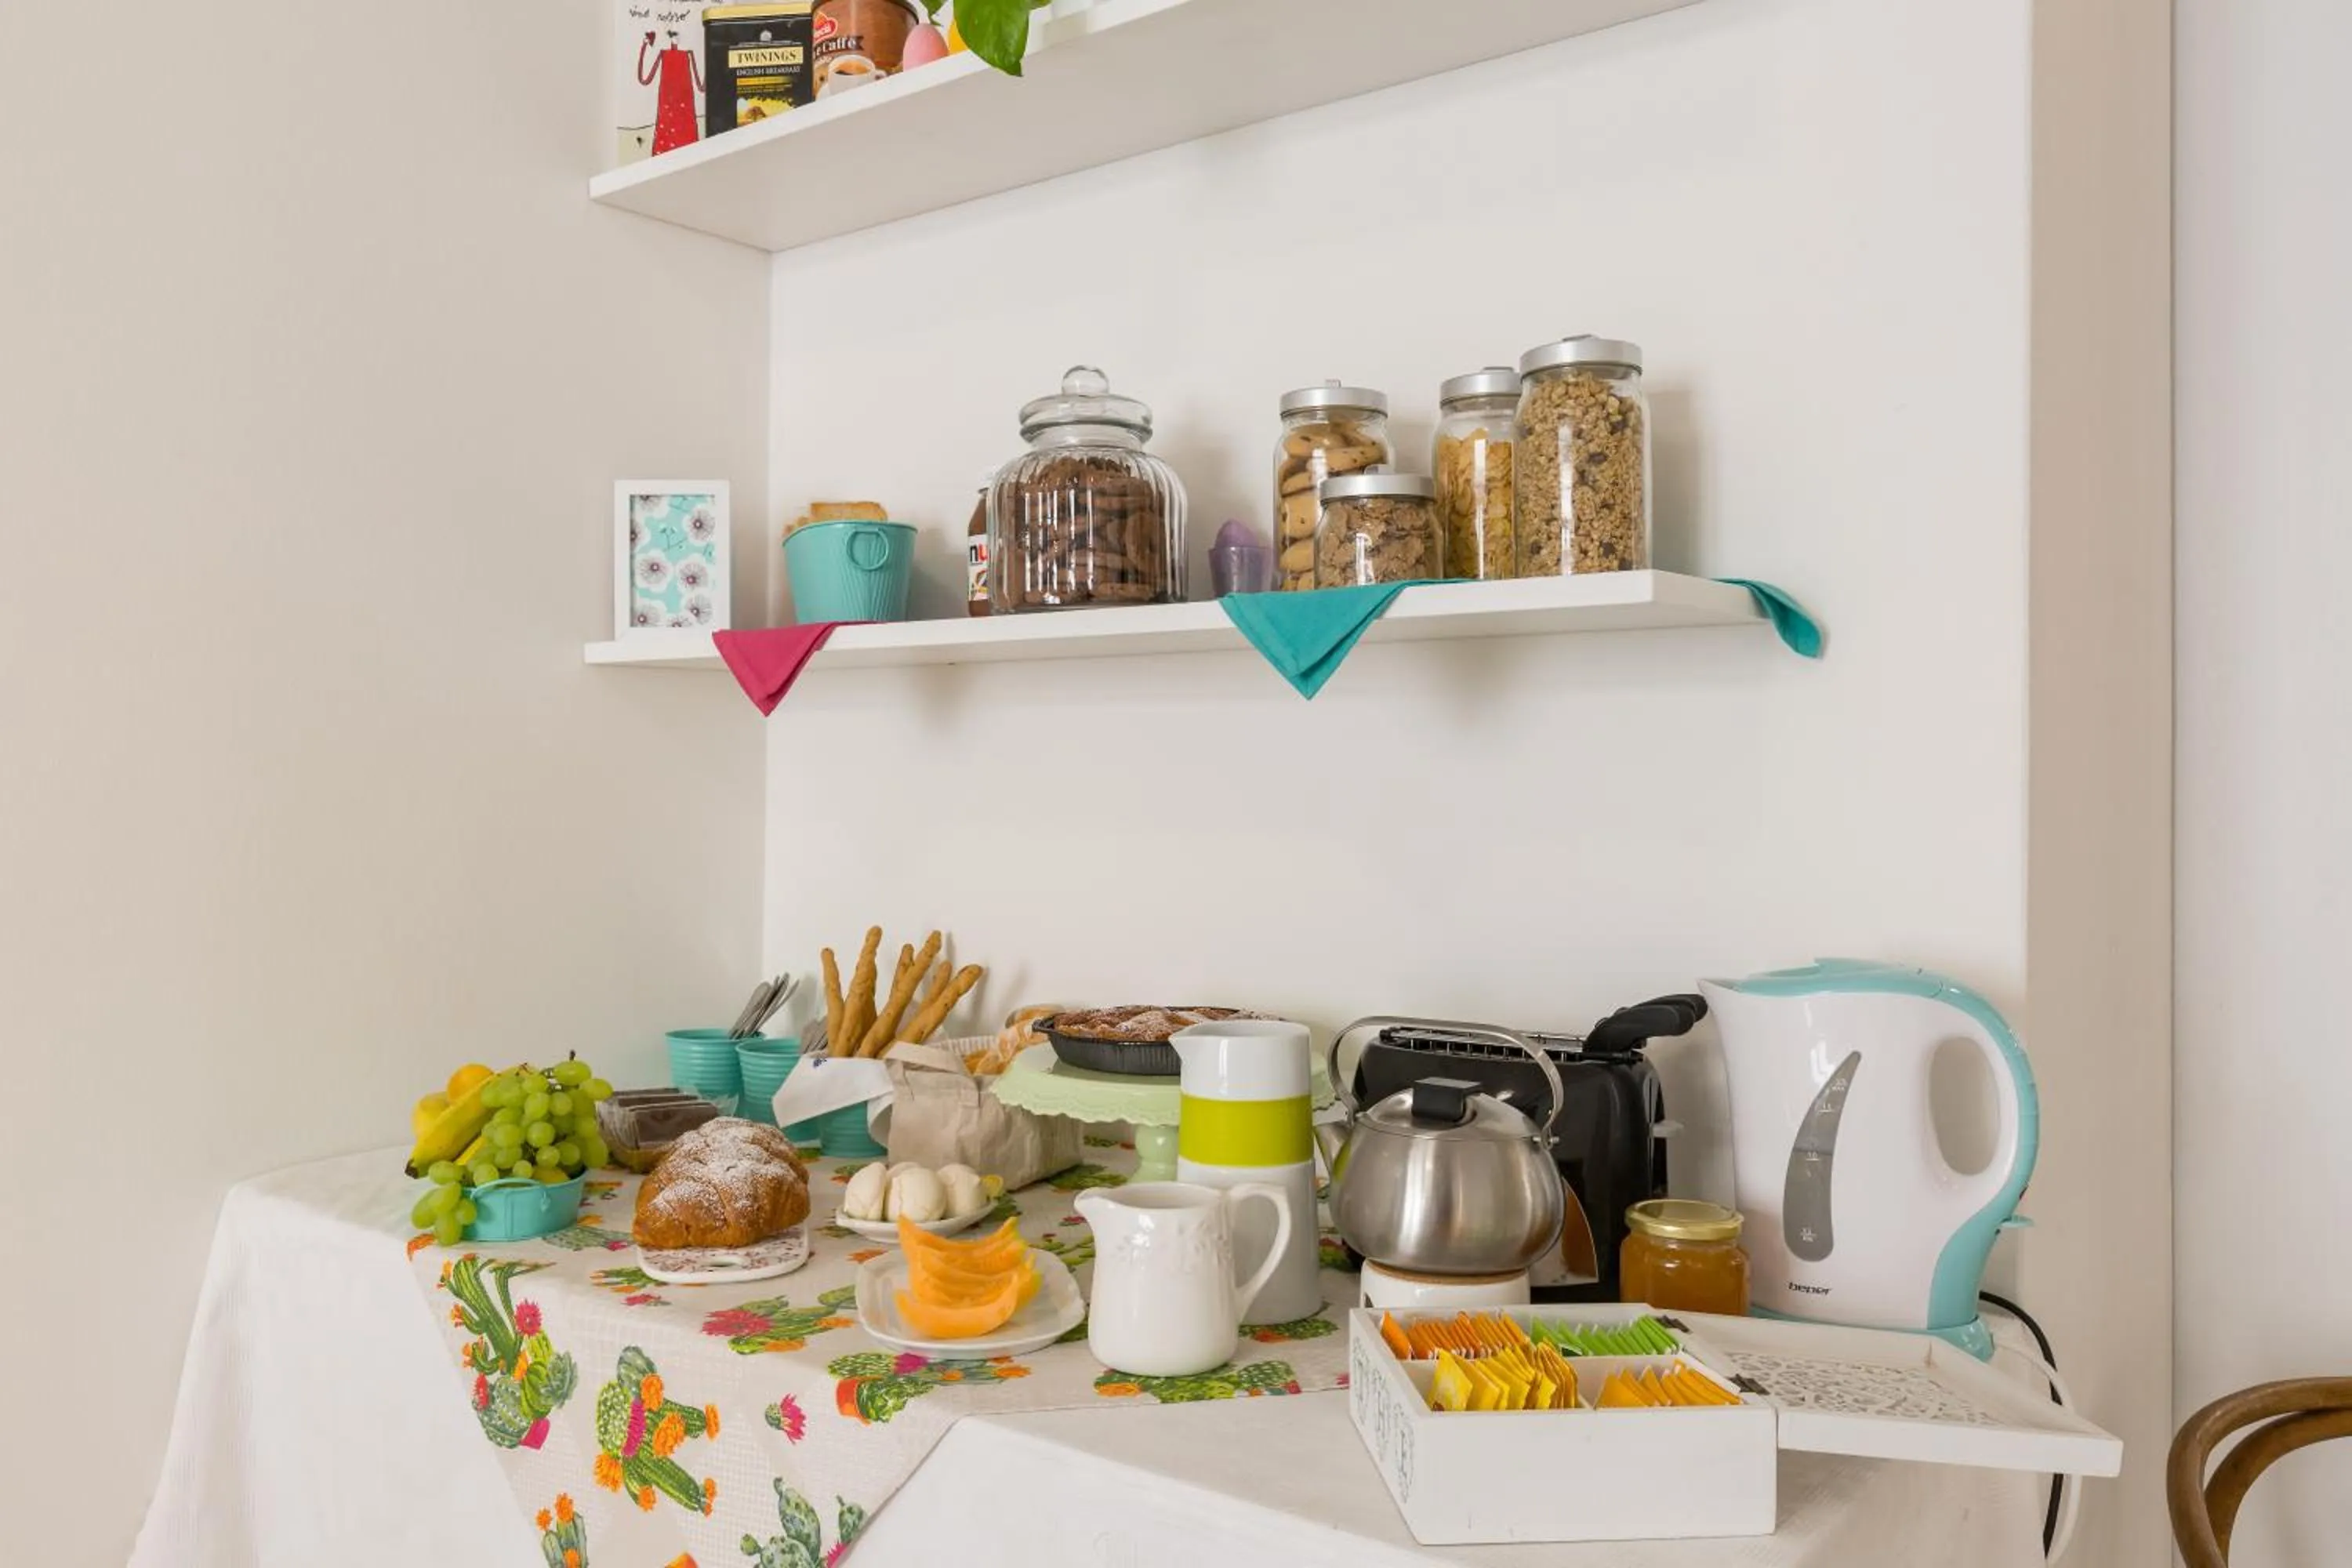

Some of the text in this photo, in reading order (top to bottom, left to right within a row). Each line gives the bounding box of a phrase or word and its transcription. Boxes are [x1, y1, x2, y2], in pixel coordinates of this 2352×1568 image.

[737, 50, 797, 64] TWININGS
[737, 65, 800, 76] ENGLISH BREAKFAST
